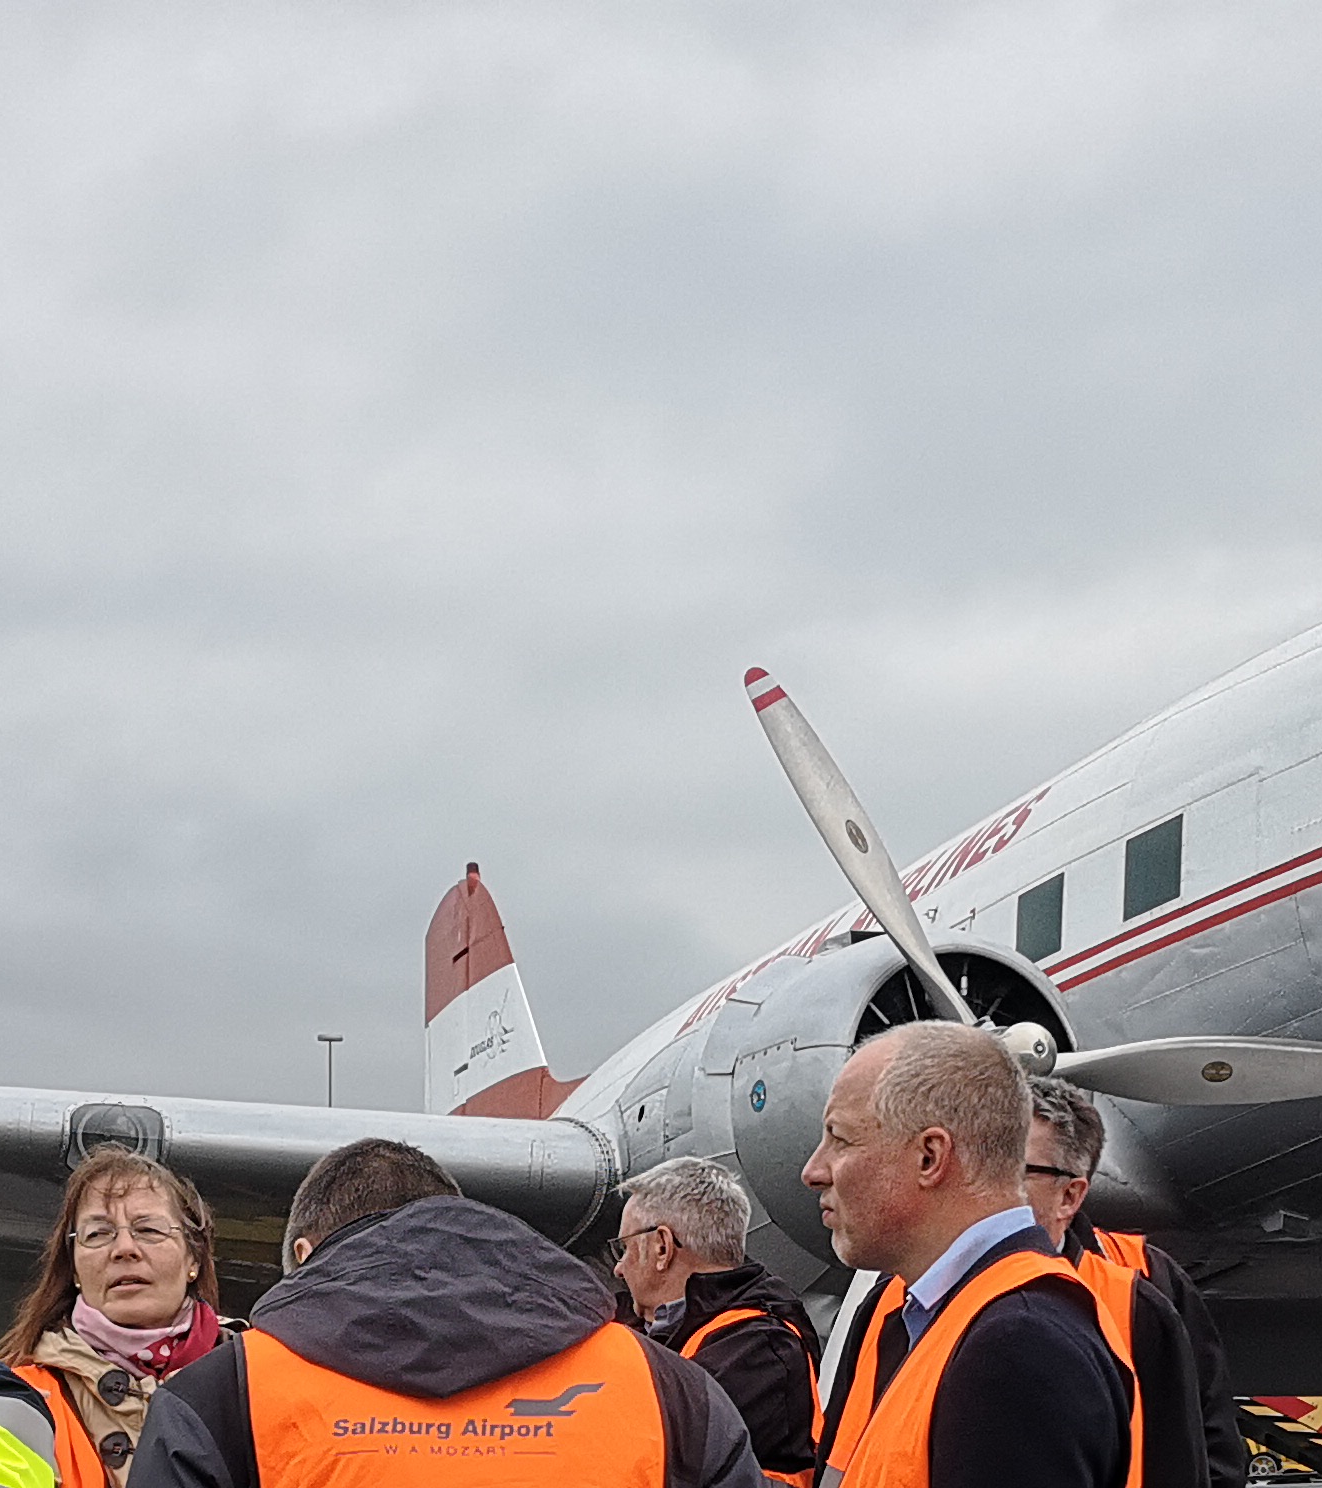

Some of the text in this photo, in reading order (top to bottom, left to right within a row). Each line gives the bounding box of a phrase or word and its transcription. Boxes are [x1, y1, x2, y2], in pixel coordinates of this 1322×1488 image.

[332, 1416, 555, 1441] Salzburg Airport
[429, 1444, 508, 1457] MOZART
